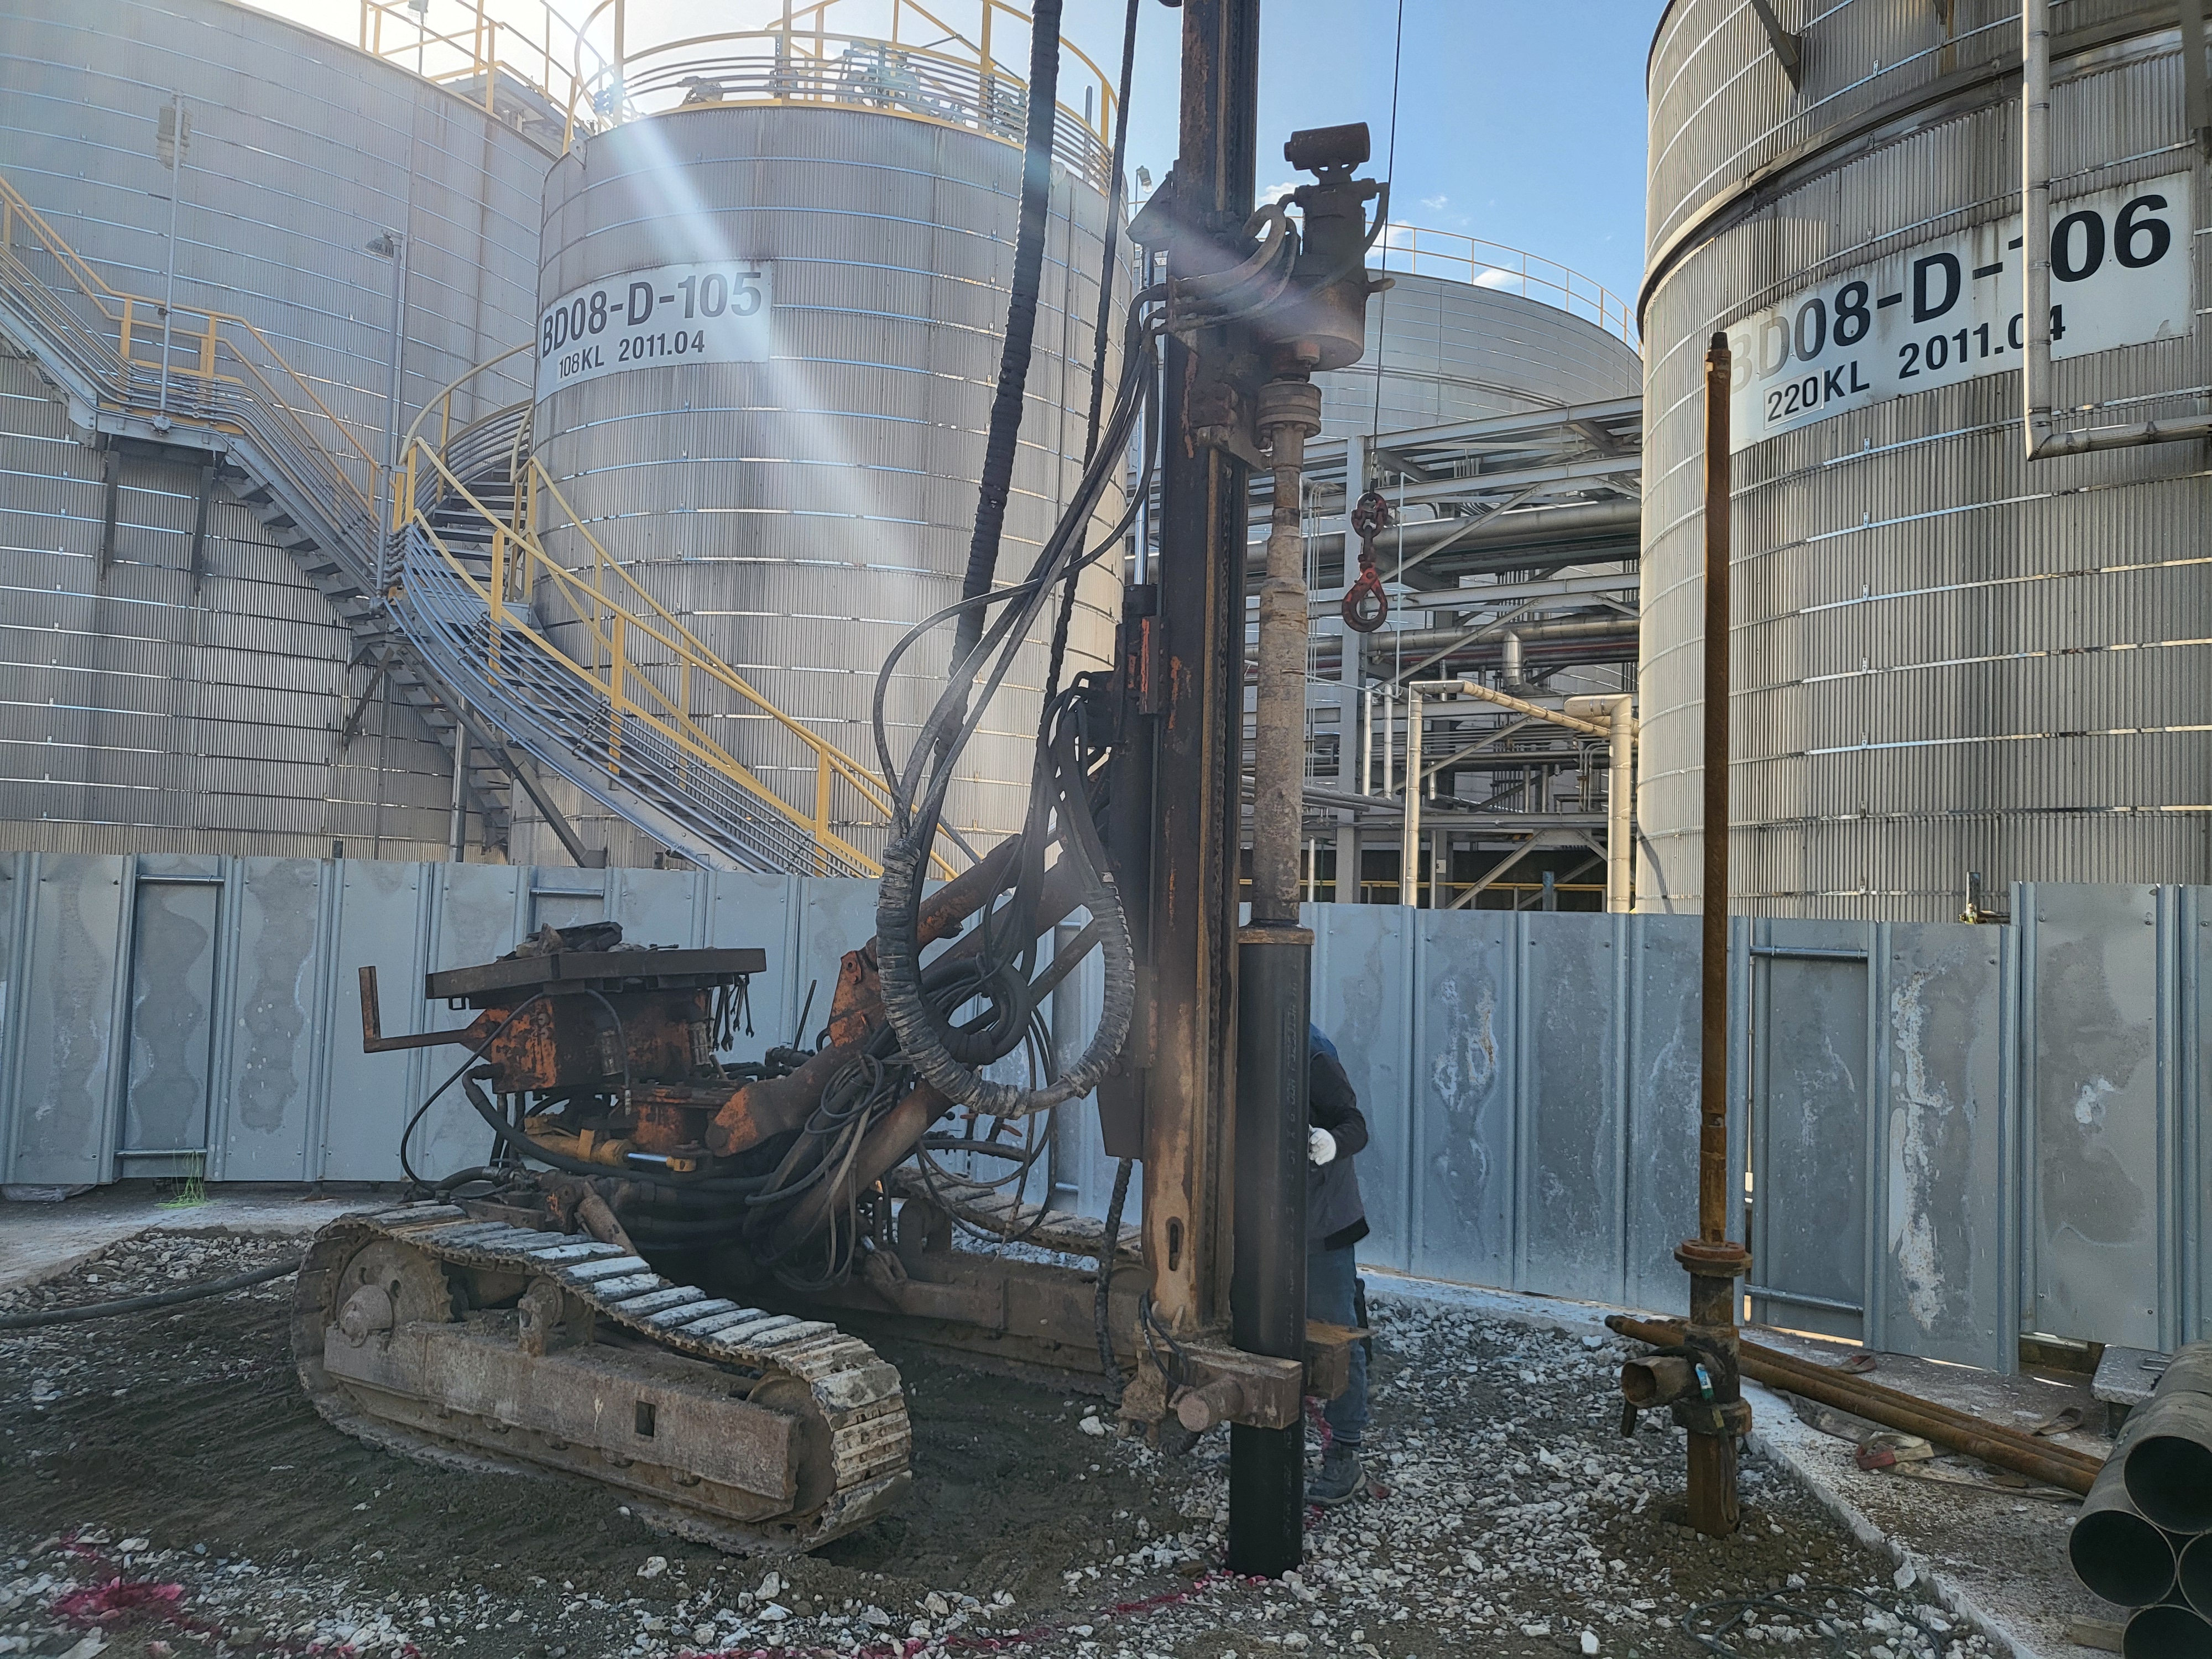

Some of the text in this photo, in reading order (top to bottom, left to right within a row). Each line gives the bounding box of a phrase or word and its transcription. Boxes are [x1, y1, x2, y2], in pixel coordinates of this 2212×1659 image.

[542, 272, 762, 359] BD08-D-105
[1729, 194, 2171, 395] BD08-D-06
[559, 330, 705, 379] 108KL 2011.04
[1767, 360, 1870, 422] 220KL
